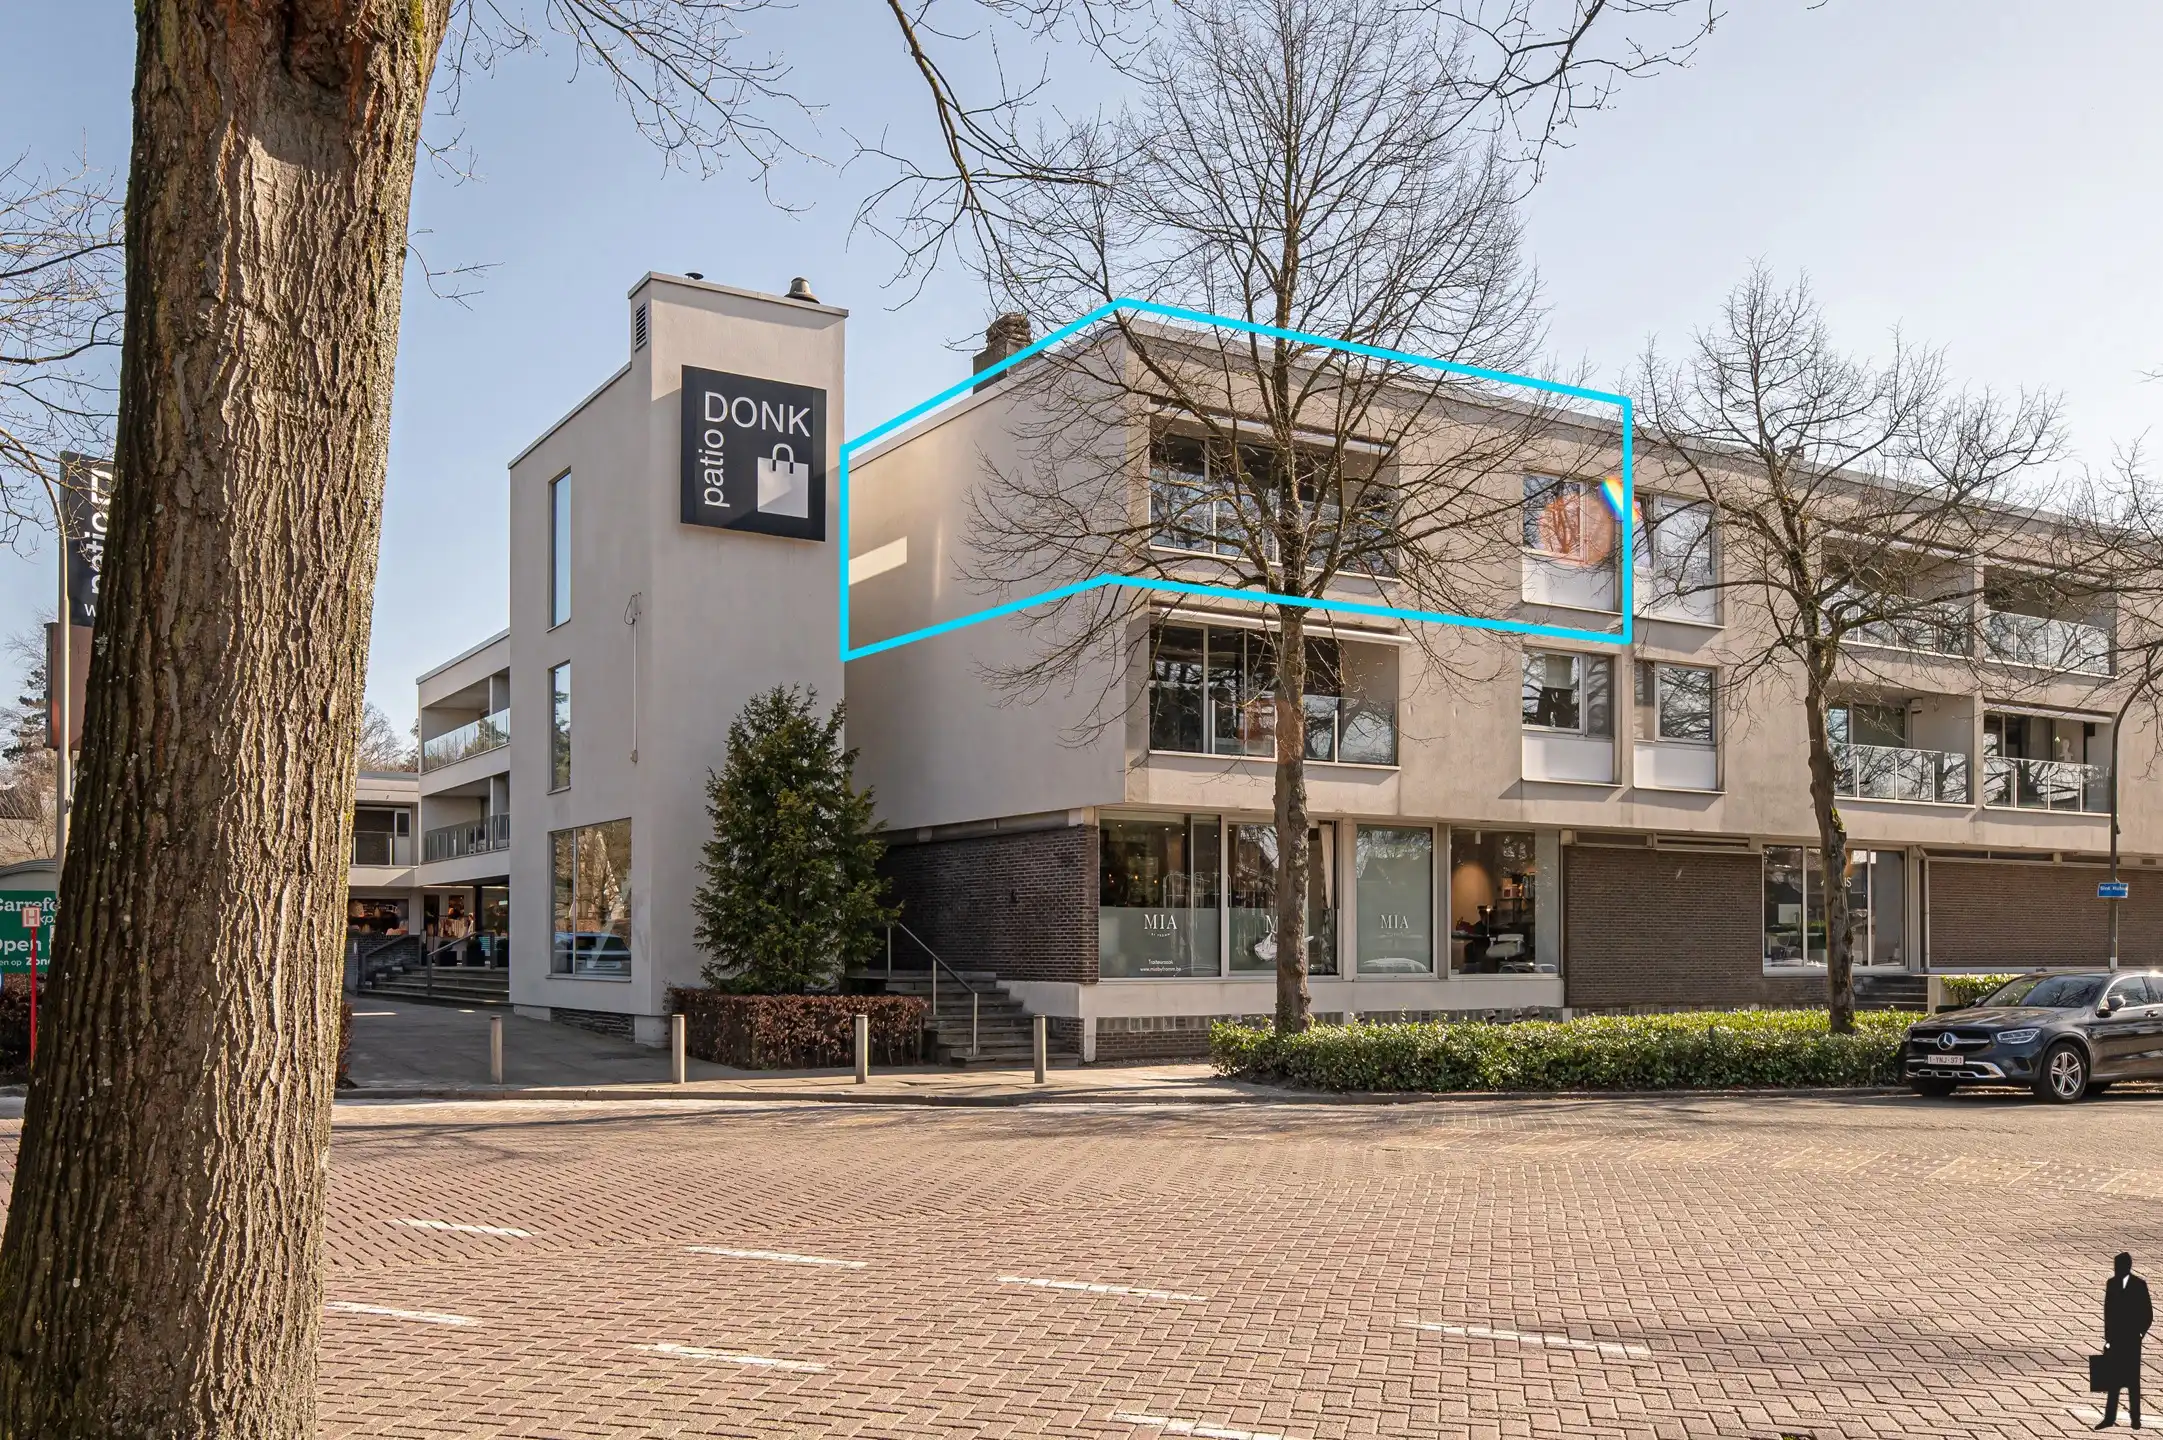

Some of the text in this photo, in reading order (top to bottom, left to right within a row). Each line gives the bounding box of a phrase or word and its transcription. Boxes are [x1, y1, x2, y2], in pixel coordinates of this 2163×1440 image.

[704, 391, 811, 438] DONK
[698, 428, 730, 508] patio
[1144, 914, 1178, 930] MIA
[1381, 914, 1409, 929] MIA
[0, 939, 42, 956] pen
[10, 959, 22, 968] op
